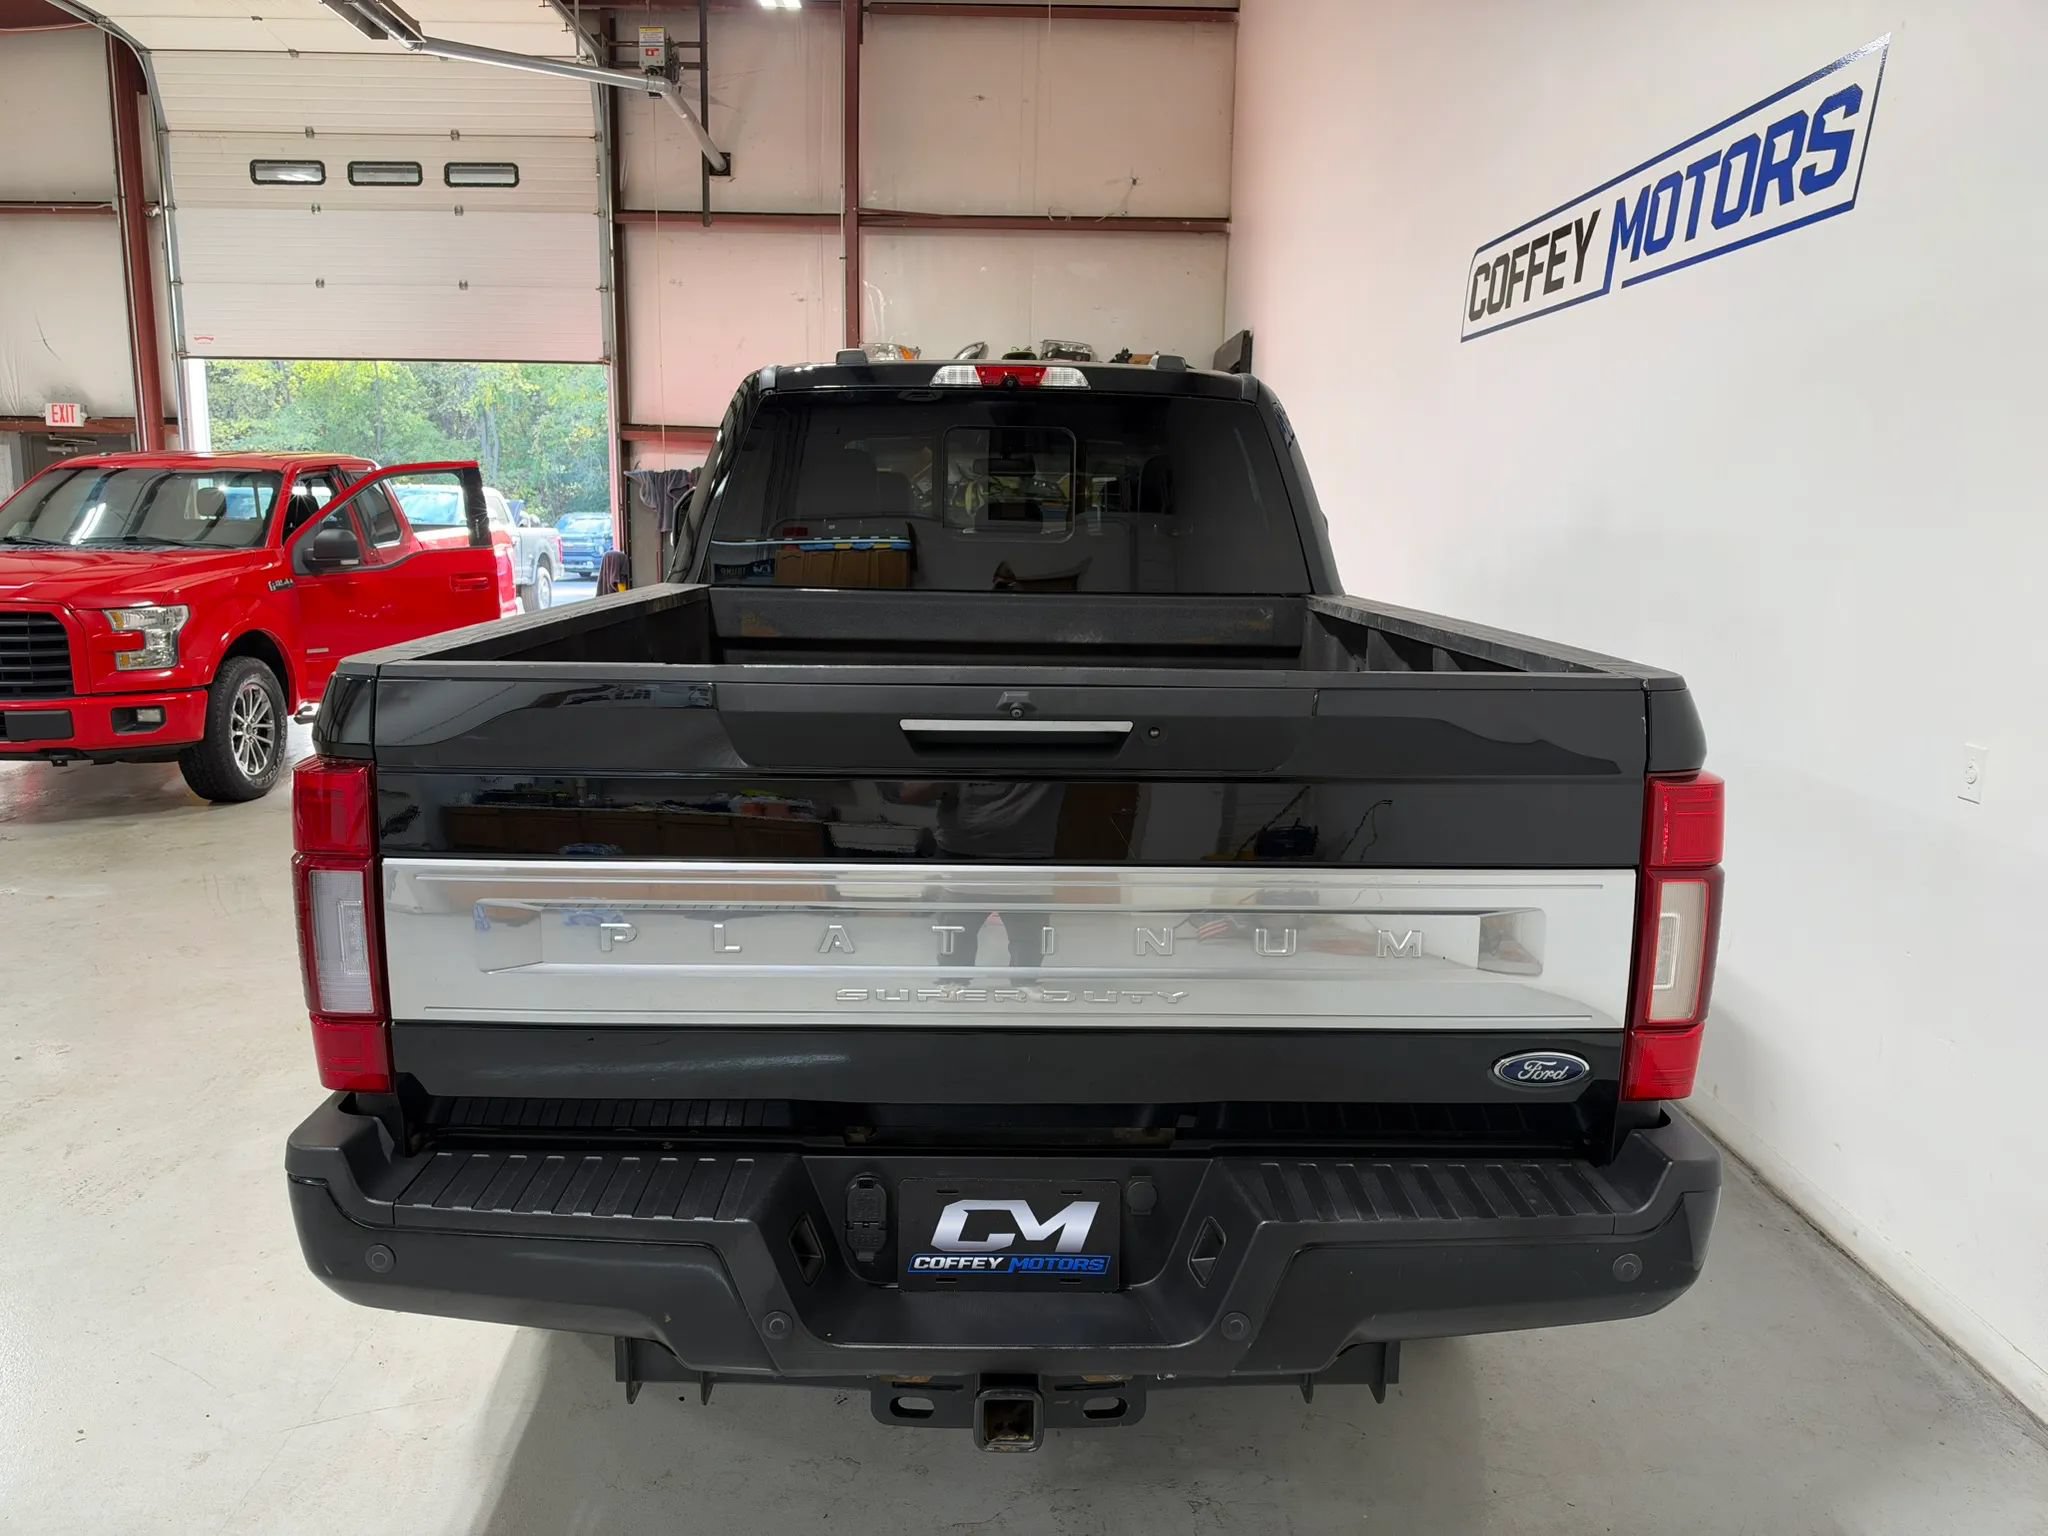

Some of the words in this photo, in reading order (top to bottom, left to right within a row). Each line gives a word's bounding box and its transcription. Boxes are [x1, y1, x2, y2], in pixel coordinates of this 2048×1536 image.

[1468, 207, 1602, 322] COFFEY
[1604, 83, 1863, 293] MOTORS
[51, 404, 75, 423] EXIT
[600, 922, 1424, 959] PLATINUM
[835, 988, 1026, 1002] SUPER
[1041, 989, 1190, 1004] DUTY
[1517, 1060, 1570, 1080] Ford
[930, 1199, 1100, 1252] CM
[913, 1256, 1005, 1270] COFFEY
[1008, 1256, 1106, 1273] MOTORS
